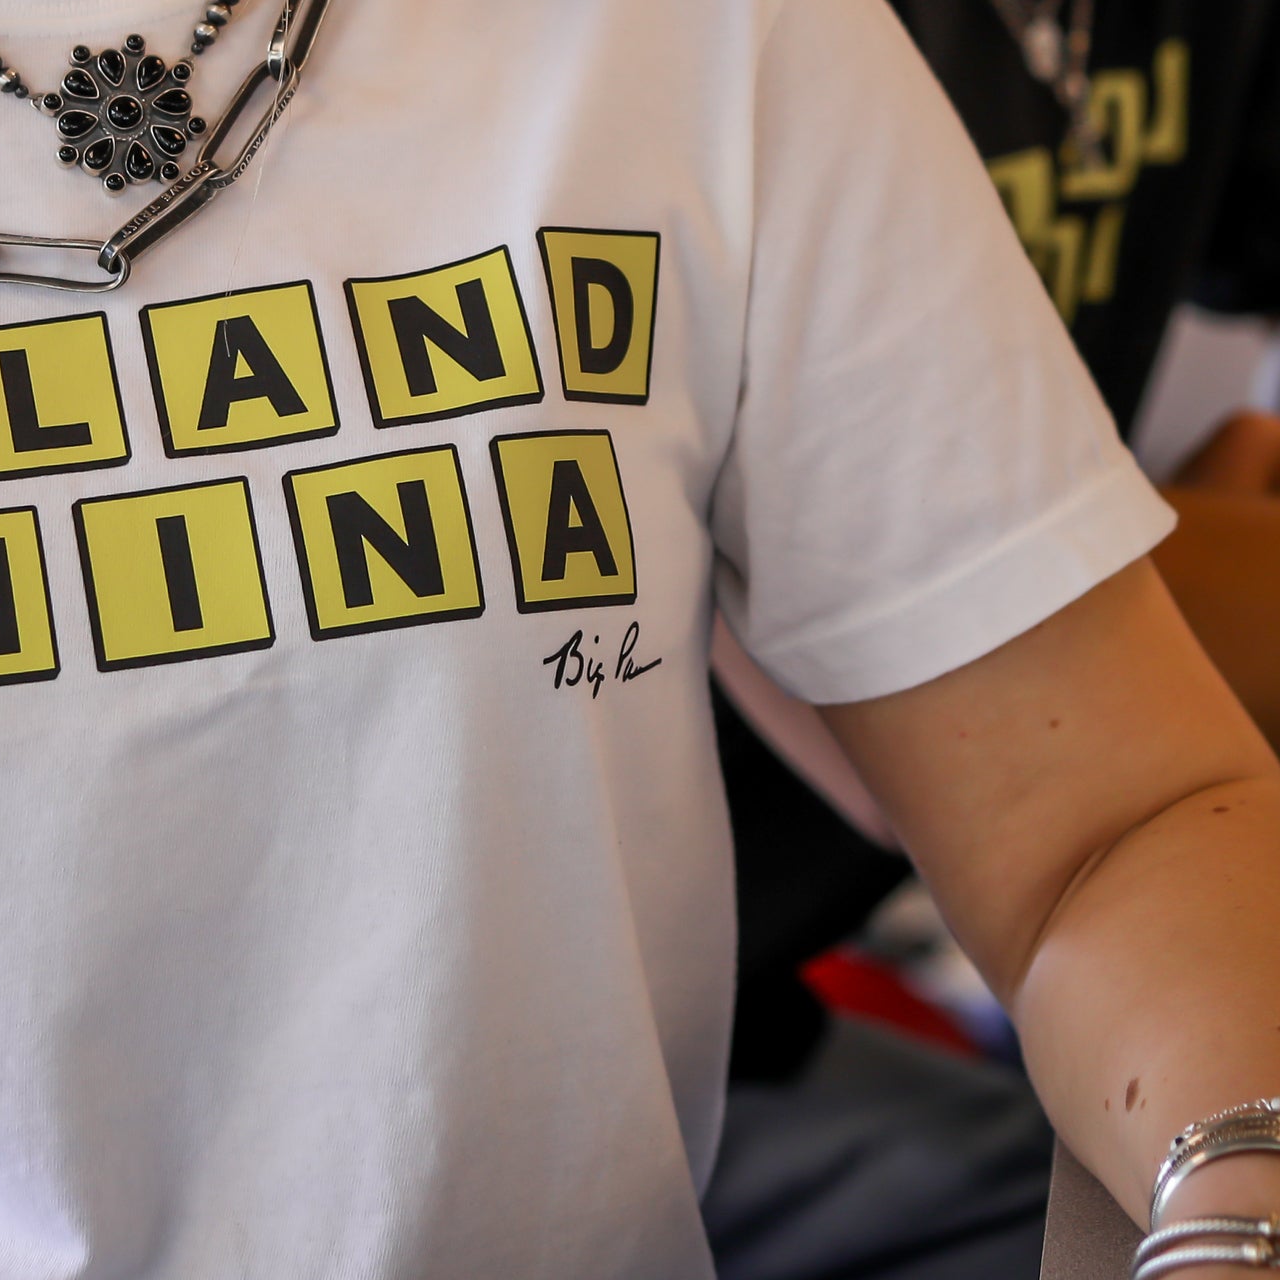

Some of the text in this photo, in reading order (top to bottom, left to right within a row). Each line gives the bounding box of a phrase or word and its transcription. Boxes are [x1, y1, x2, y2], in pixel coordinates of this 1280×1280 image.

[121, 163, 210, 240] GOD WE TRUST
[231, 154, 253, 182] GOD
[543, 629, 605, 700] Big
